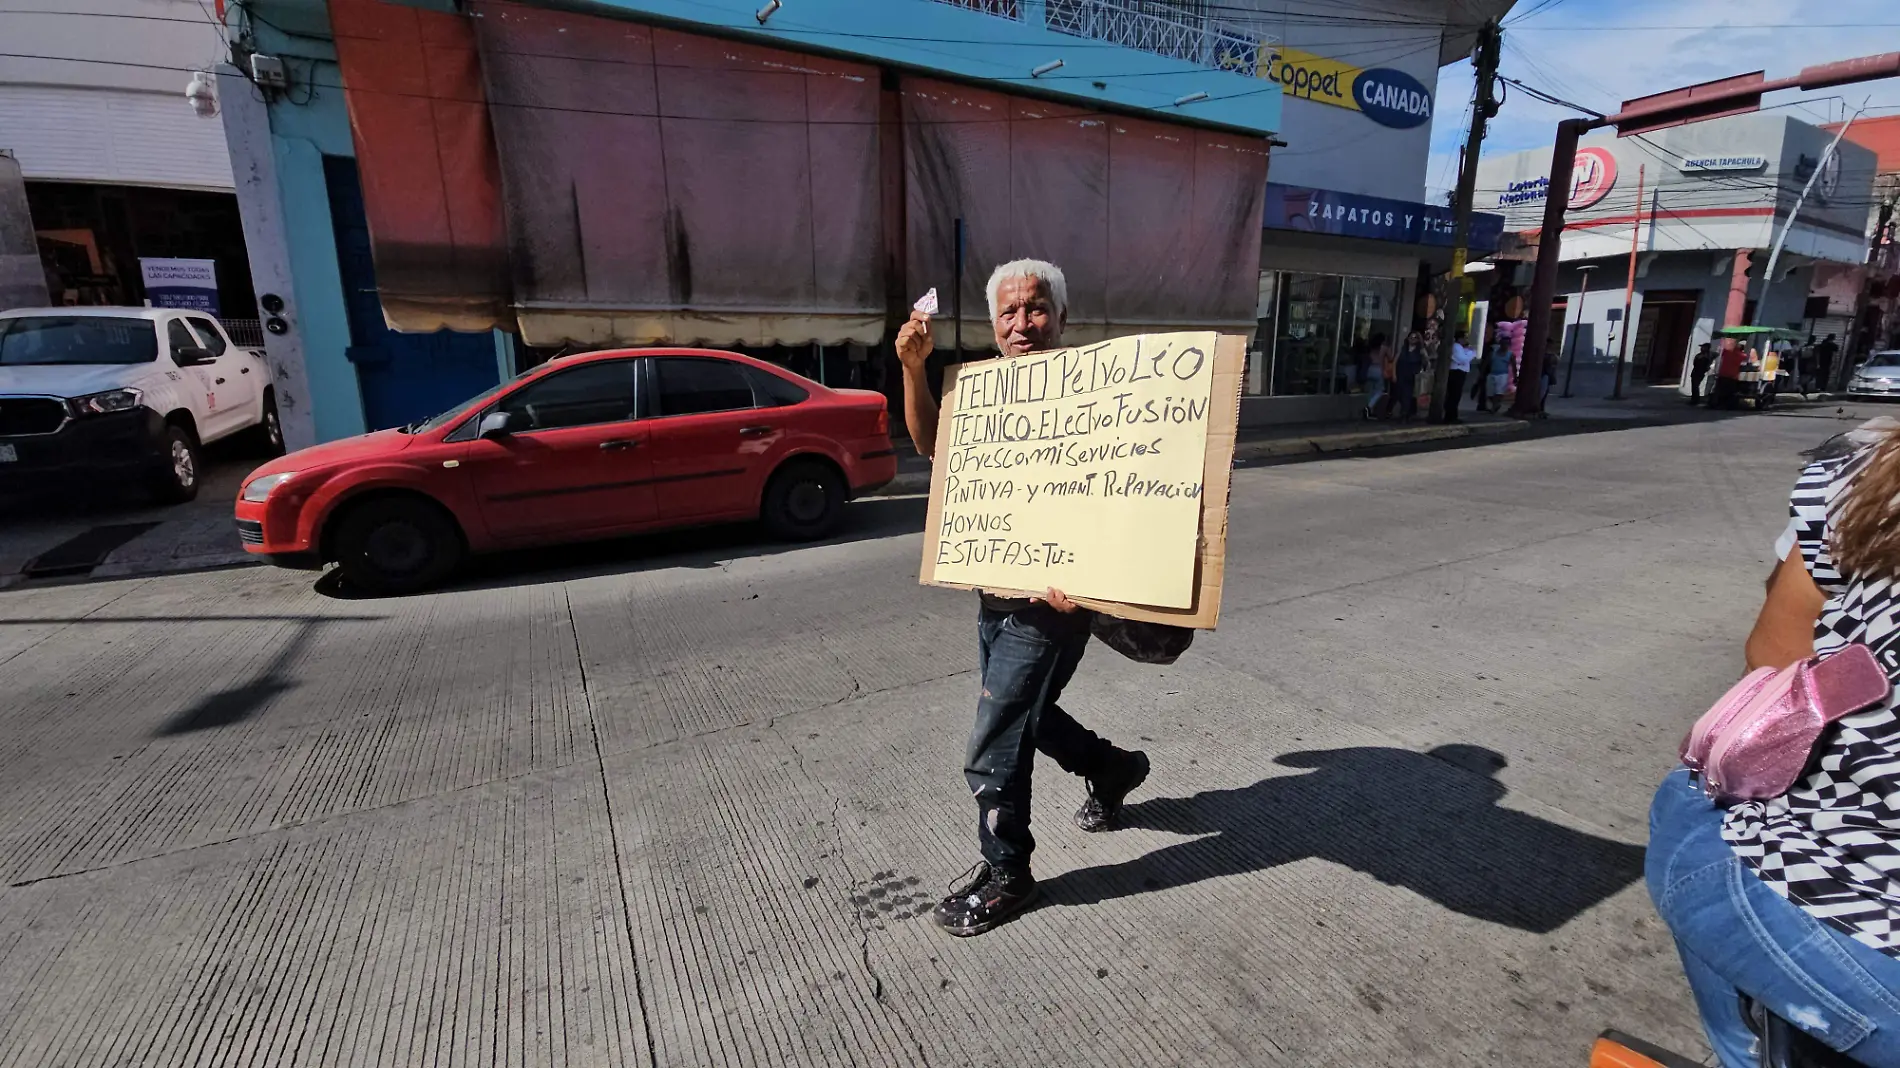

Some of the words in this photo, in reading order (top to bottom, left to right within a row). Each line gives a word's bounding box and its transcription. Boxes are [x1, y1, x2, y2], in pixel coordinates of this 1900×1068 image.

[1268, 54, 1342, 98] Coppel
[1362, 79, 1430, 117] CANADA
[1685, 158, 1717, 168] AGENCIA
[1719, 157, 1761, 166] TAPACHULA
[1309, 201, 1394, 227] ZAPATOS
[1404, 214, 1414, 229] Y
